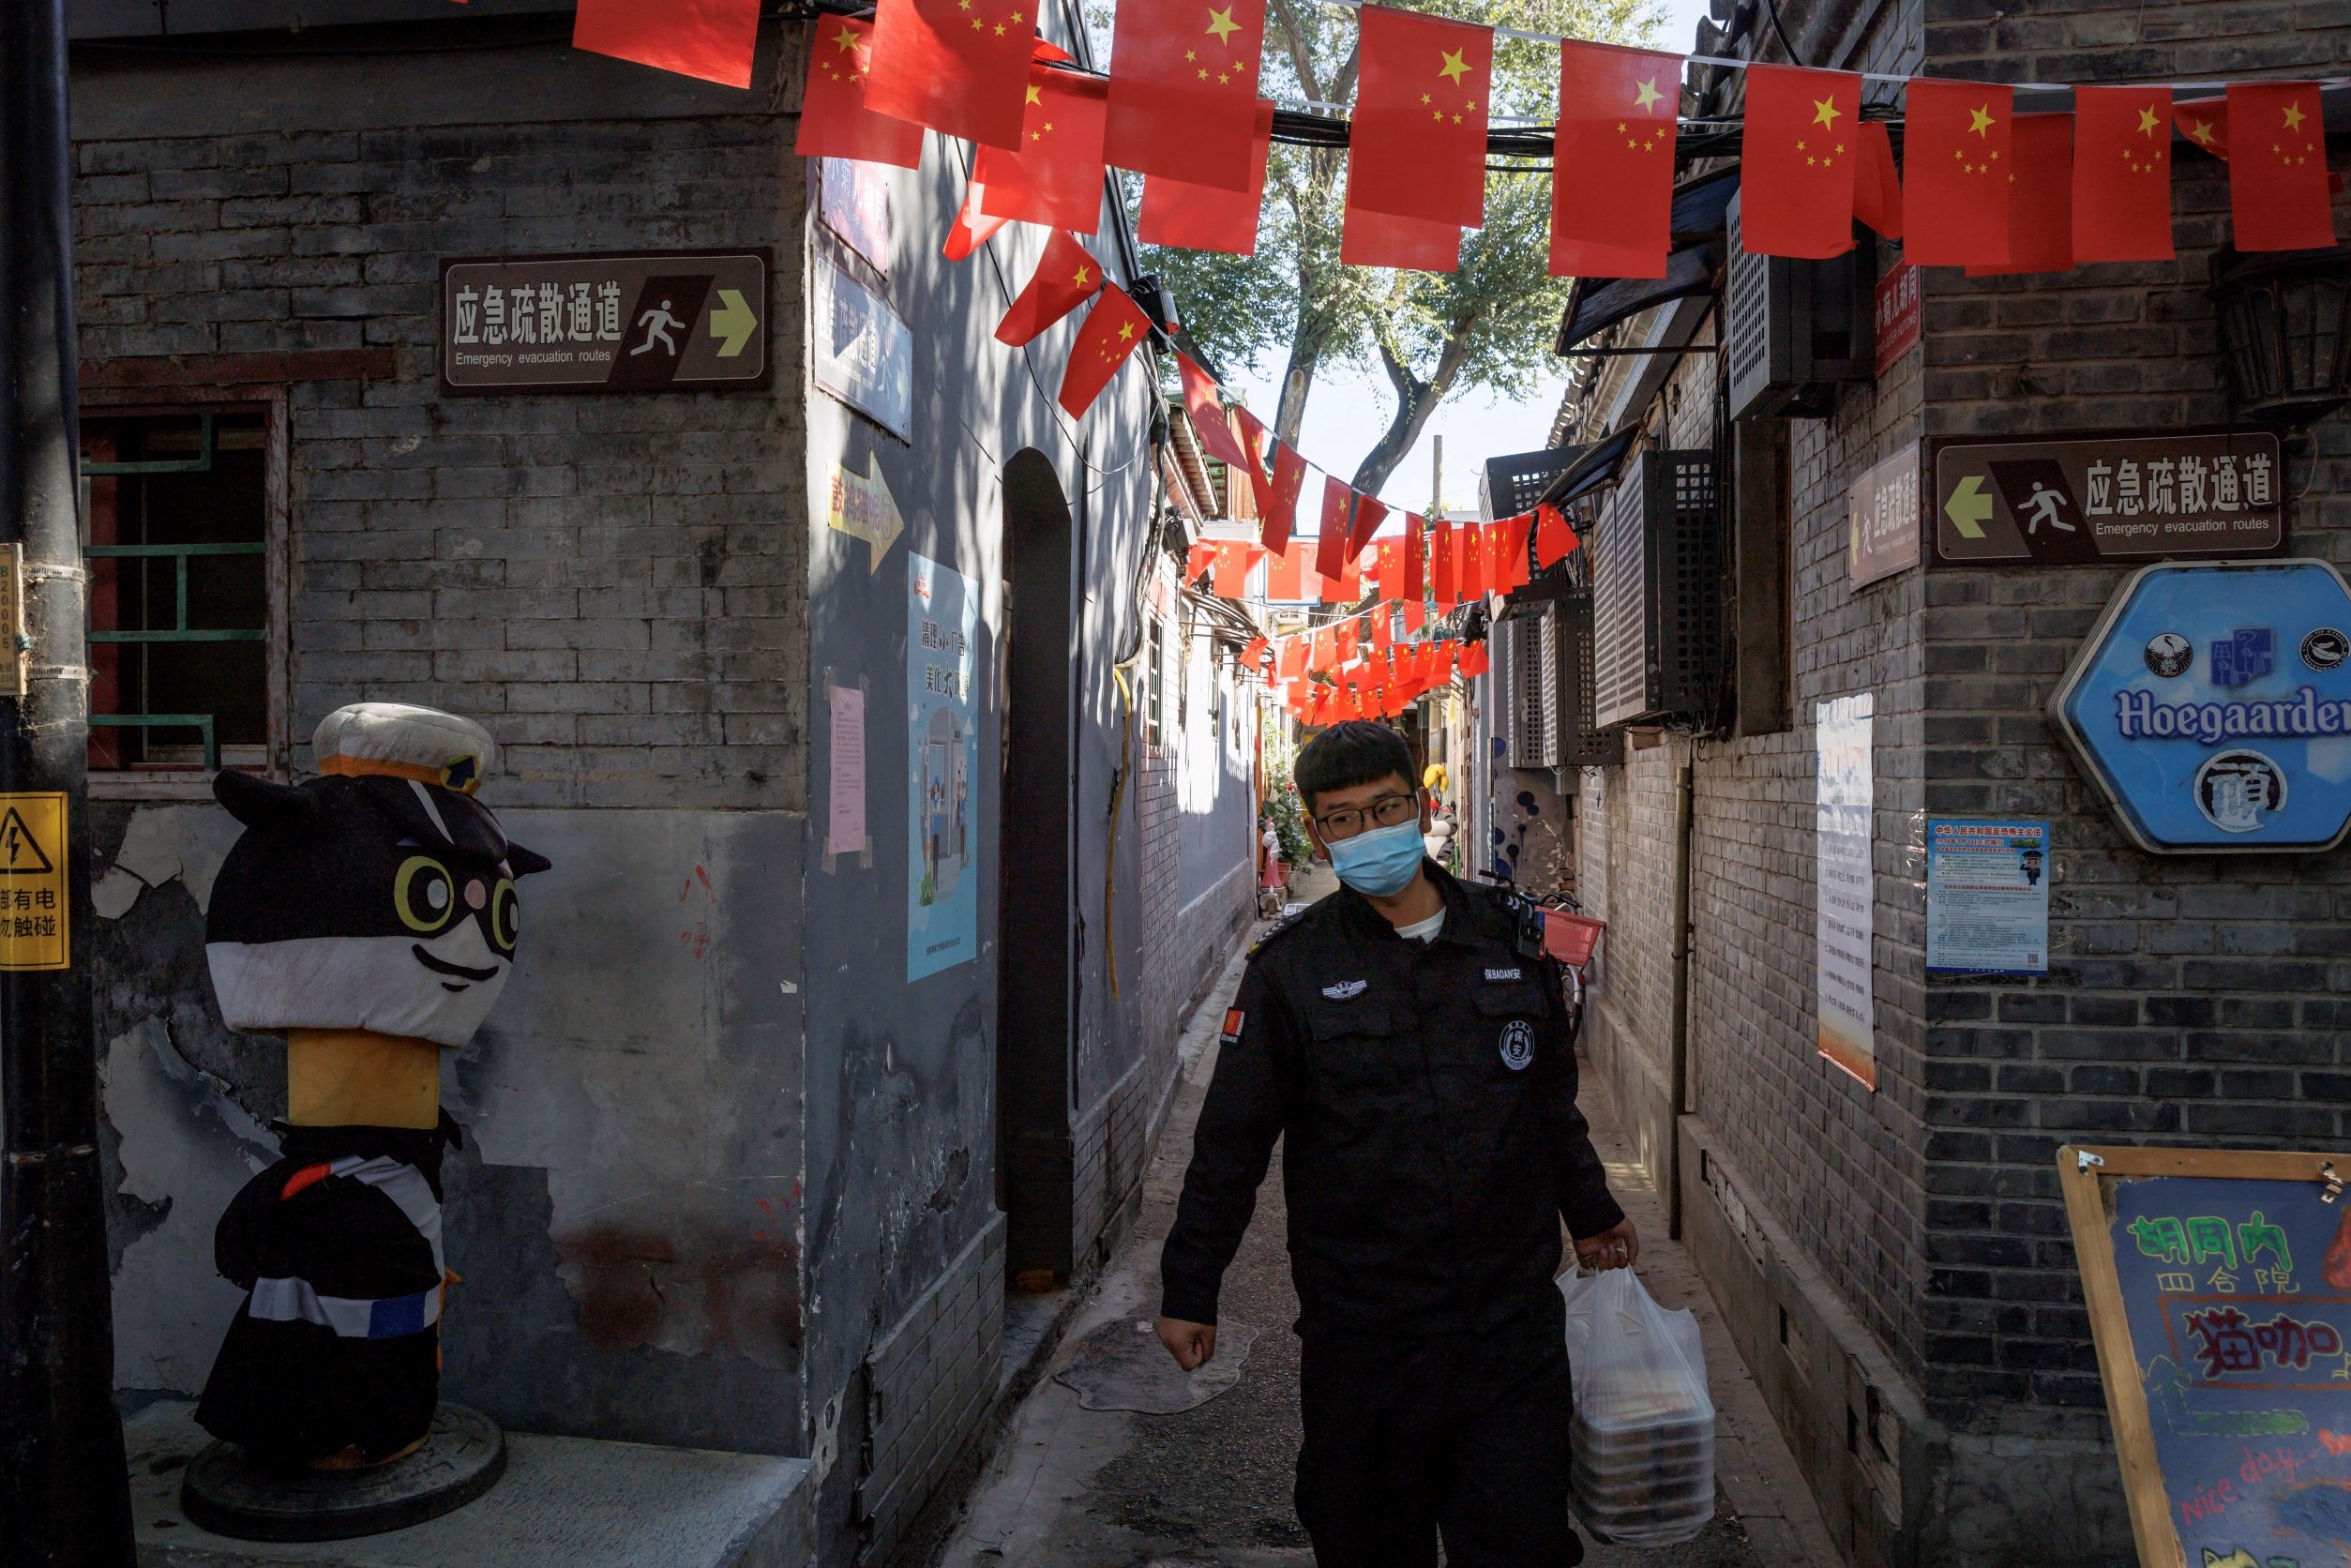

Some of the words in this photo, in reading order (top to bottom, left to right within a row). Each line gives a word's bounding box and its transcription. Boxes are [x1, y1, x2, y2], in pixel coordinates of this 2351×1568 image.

[453, 279, 622, 346] 应急疏散通道
[456, 352, 513, 367] Emergency
[519, 349, 574, 364] evacuation
[579, 349, 611, 362] routes
[1874, 467, 1917, 537] 应急疏散通道
[2084, 452, 2273, 519] 应急疏散通道
[2095, 521, 2159, 537] Emergency
[2164, 520, 2226, 534] evacuation
[2233, 518, 2270, 532] routes
[922, 619, 966, 656] 清理小广告
[1936, 825, 2042, 837] 中华人民共和国反恐怖主义法
[2127, 1211, 2293, 1272] 胡同内
[2158, 1262, 2300, 1294] 四合院
[2183, 1305, 2343, 1380] 猫咖
[2238, 1444, 2297, 1485] day
